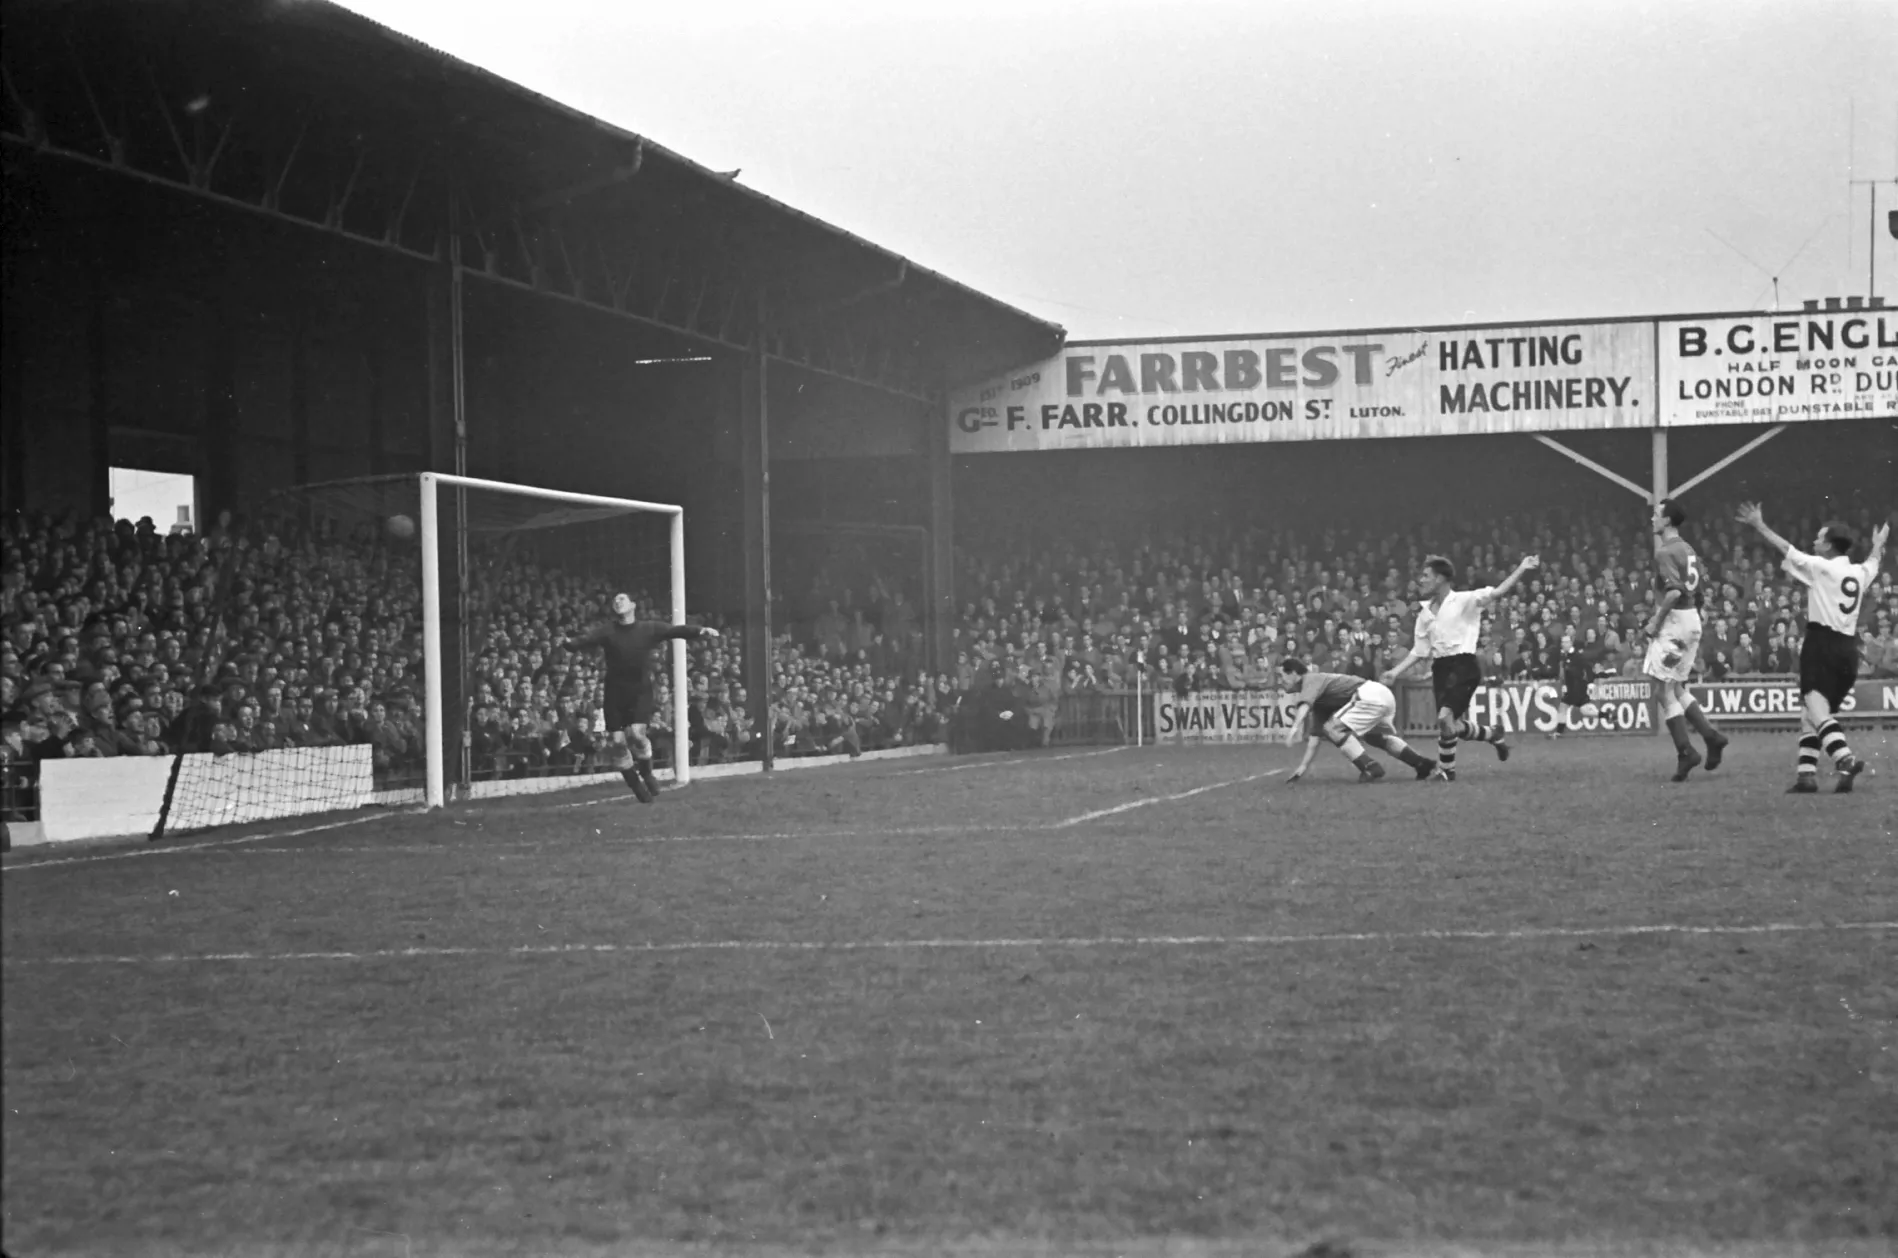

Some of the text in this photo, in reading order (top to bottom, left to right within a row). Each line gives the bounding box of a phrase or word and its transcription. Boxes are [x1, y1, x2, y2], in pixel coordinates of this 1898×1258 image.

[1439, 334, 1582, 371] HATTING
[1728, 360, 1781, 373] HALF
[1796, 356, 1857, 371] MOON
[1066, 343, 1385, 397] FARRBEST
[1679, 375, 1795, 400] LONDON
[1856, 371, 1898, 392] DU
[1440, 376, 1640, 414] MACHINERY.
[1715, 400, 1746, 409] PHONE
[1778, 401, 1874, 415] DUNSTABLE
[1006, 405, 1031, 431] F.
[1041, 402, 1138, 430] FARR.
[1147, 400, 1294, 425] COLLINGDON
[1350, 406, 1405, 419] LUTON.
[1684, 555, 1699, 592] 5
[1838, 576, 1860, 615] 9
[1160, 703, 1296, 733] SWAN VESTAS
